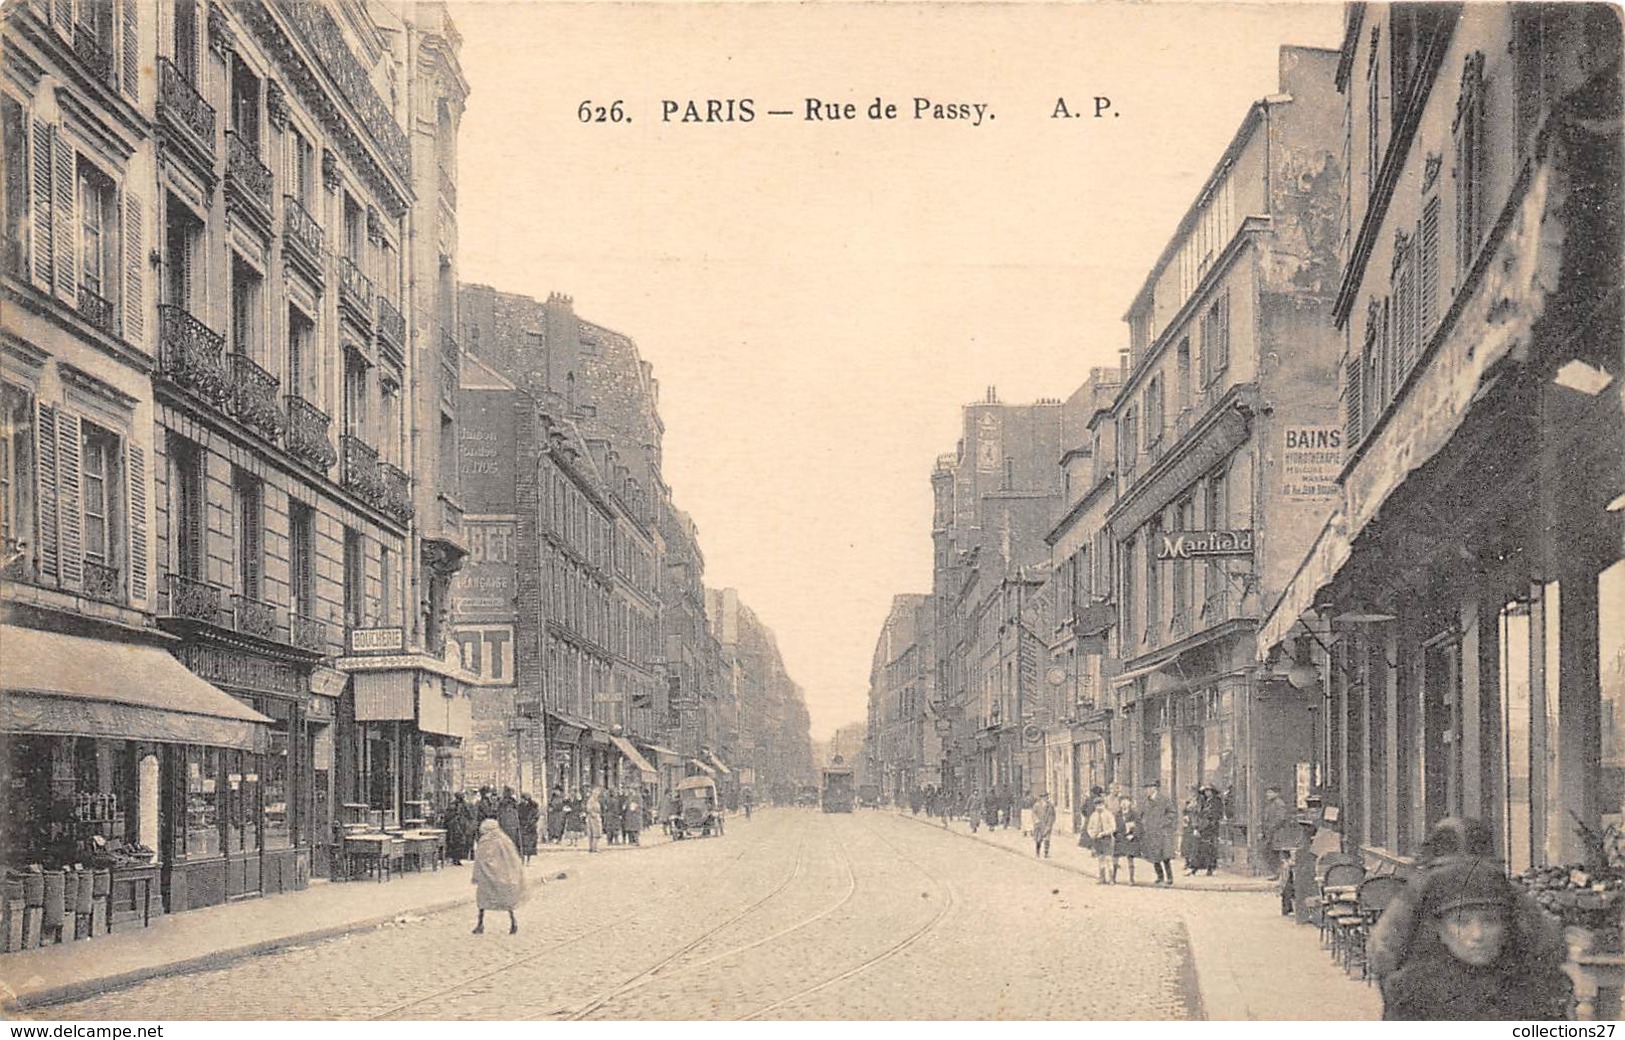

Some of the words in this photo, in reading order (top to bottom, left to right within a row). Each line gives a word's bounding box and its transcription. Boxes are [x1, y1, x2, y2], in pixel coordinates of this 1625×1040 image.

[1286, 429, 1341, 448] BAINS
[1157, 532, 1251, 558] Manfield
[354, 631, 400, 648] BOUCHERIE
